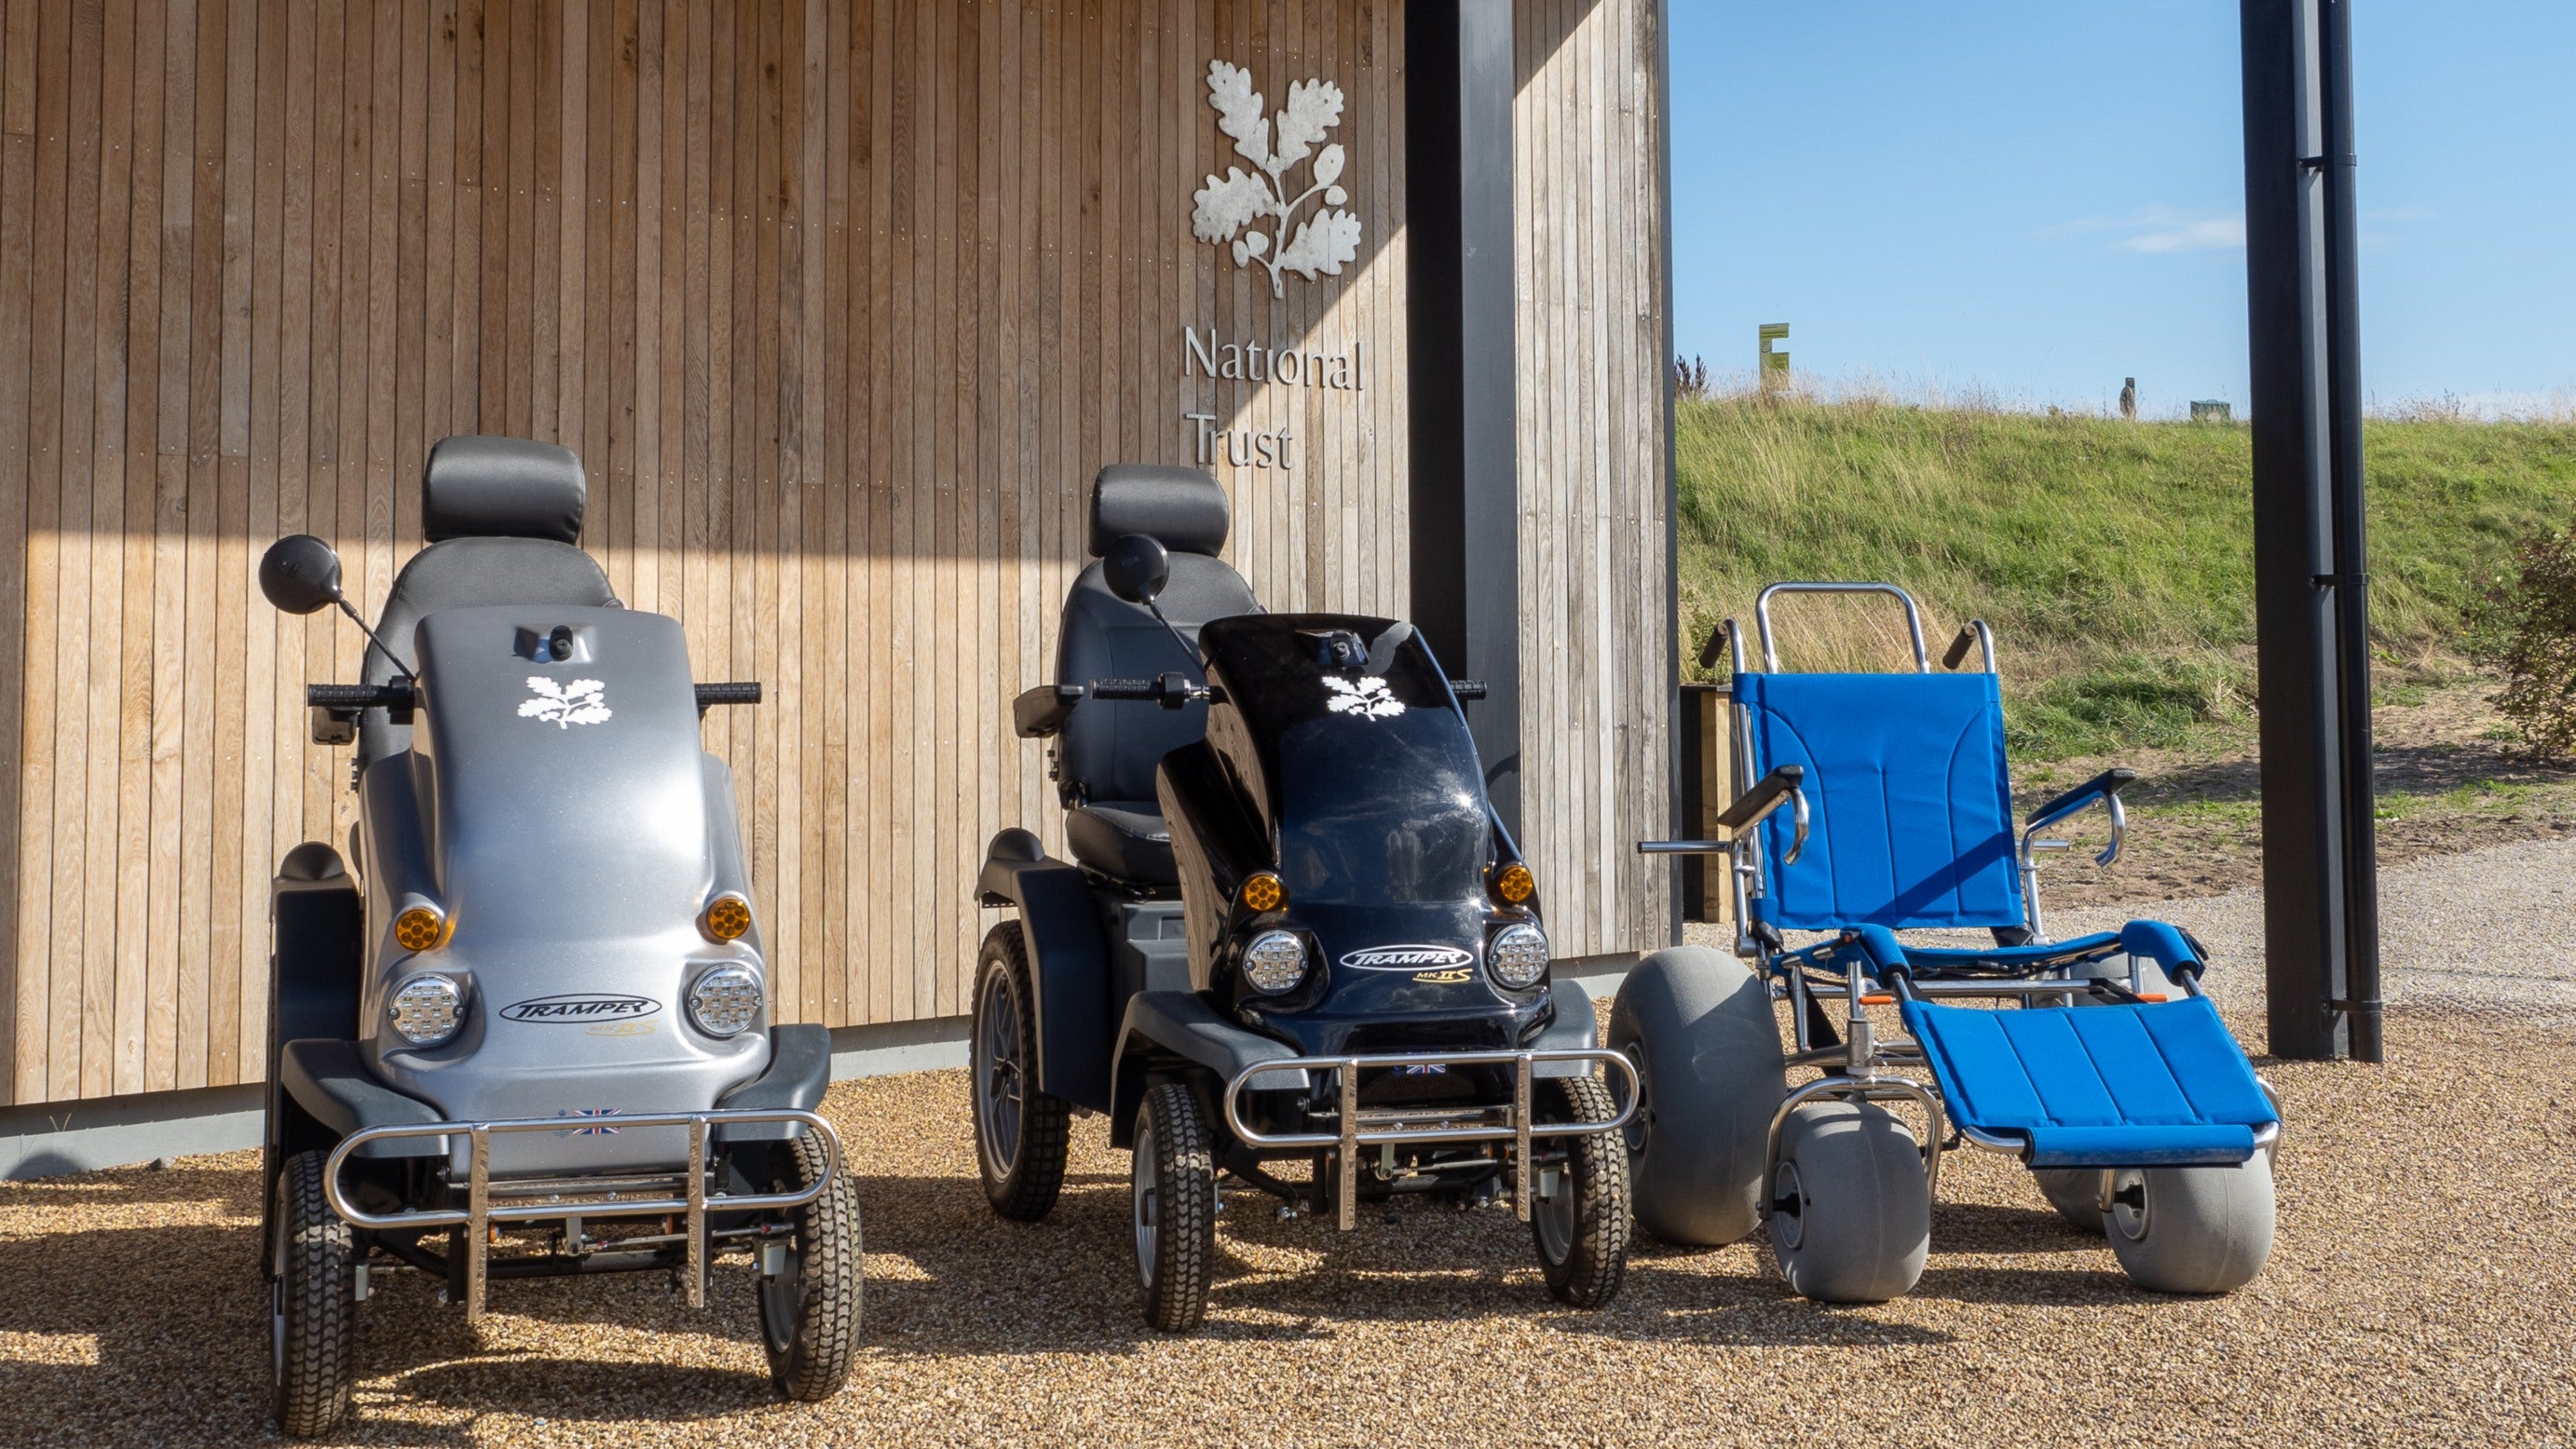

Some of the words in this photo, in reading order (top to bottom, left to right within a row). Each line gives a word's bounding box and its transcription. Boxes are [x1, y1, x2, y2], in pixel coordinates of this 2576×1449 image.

[1184, 326, 1367, 391] National
[1185, 413, 1295, 470] Trust
[1354, 952, 1462, 965] TRAMPER
[515, 1000, 648, 1019] TRAMPER
